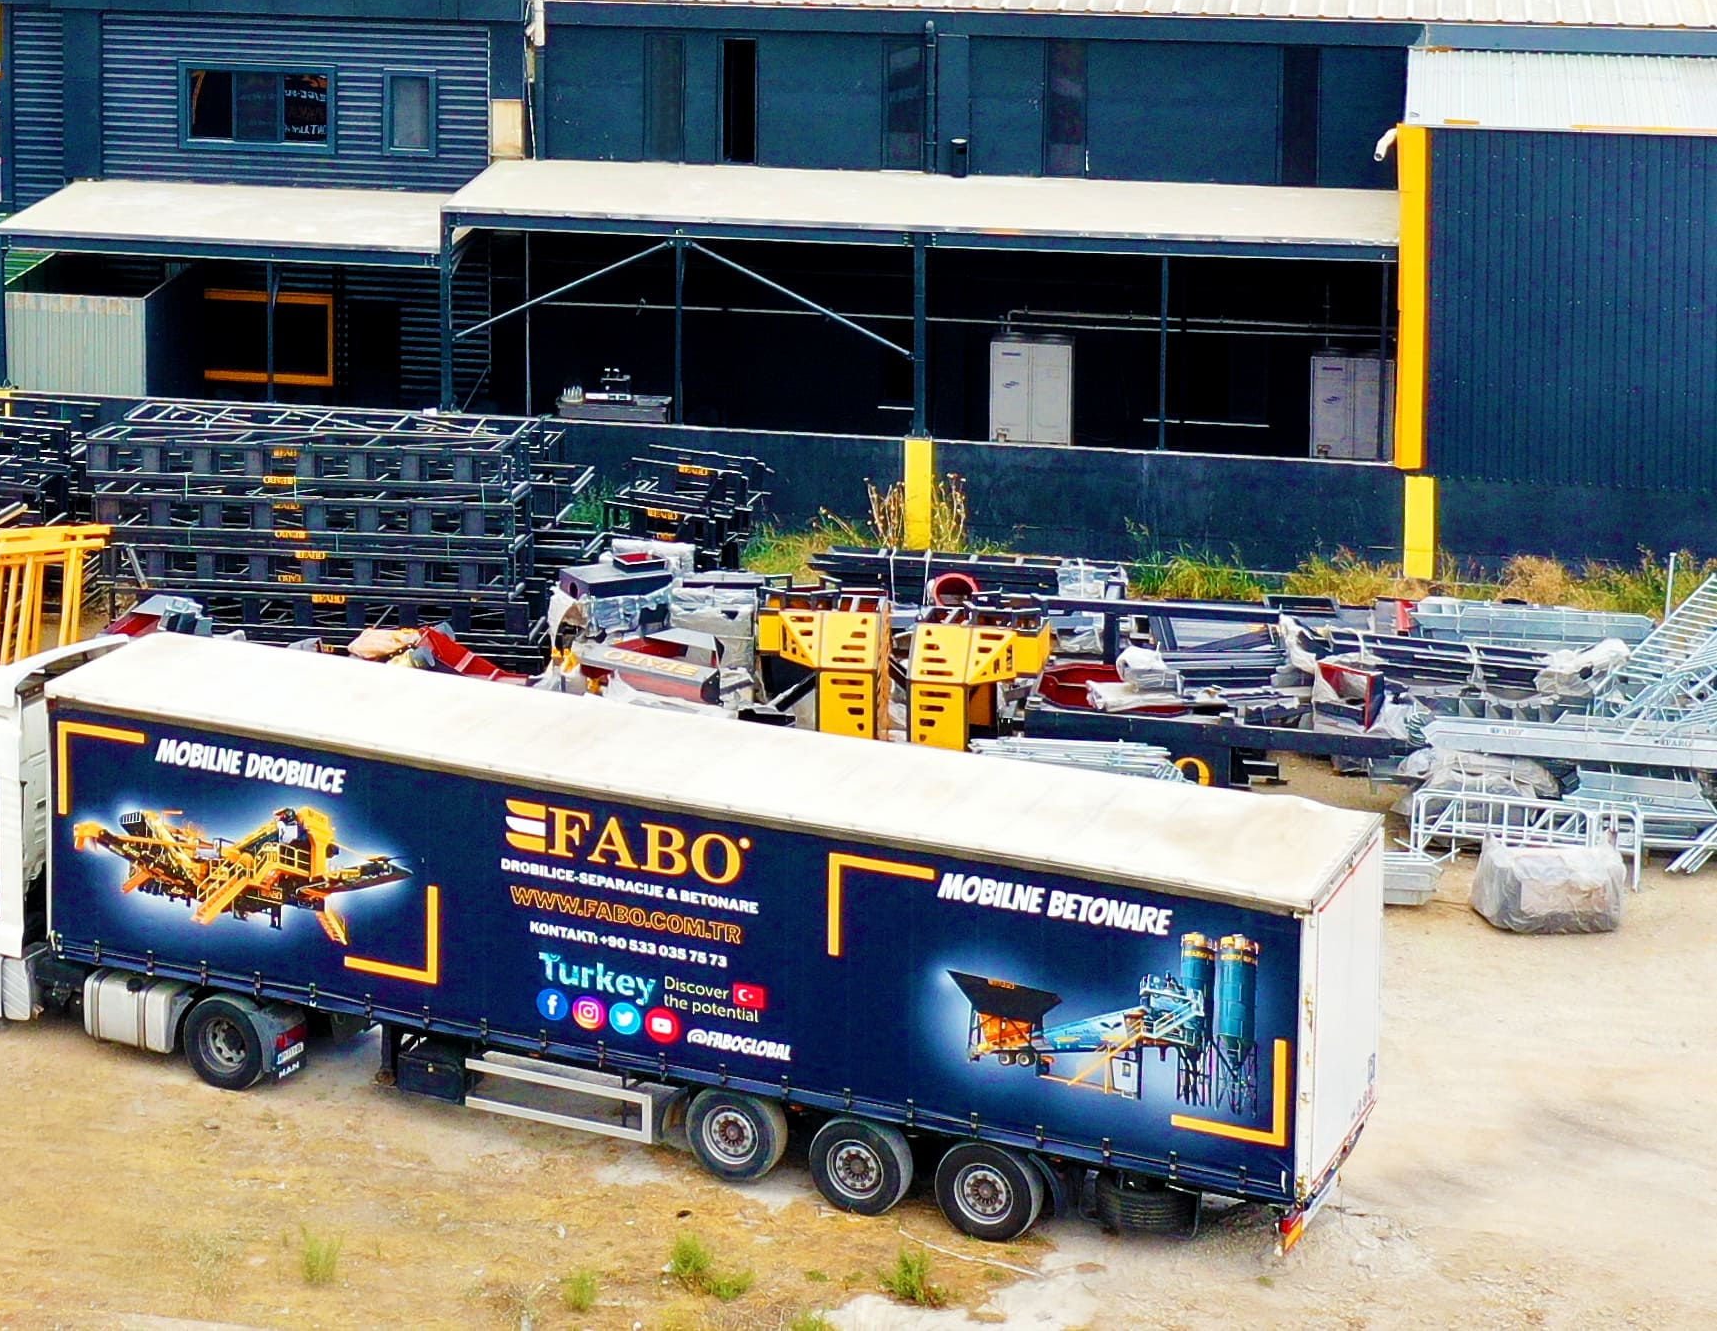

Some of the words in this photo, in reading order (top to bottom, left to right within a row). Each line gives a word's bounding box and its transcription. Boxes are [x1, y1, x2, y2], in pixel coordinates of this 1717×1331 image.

[155, 738, 243, 775] MOBILNE
[245, 753, 347, 794] DROBILICE
[548, 807, 742, 885] FABO
[500, 857, 664, 899] DROBILICE-SEPARACIJE
[665, 886, 679, 901] &
[680, 889, 760, 915] BETONARE
[937, 872, 1045, 913] MOBILNE
[1047, 890, 1173, 935] BETONARE
[510, 885, 742, 945] WWW.FABO.COM.TR
[529, 920, 598, 945] KONTAKT:
[599, 933, 628, 950] +90
[629, 939, 657, 956] 533
[658, 944, 687, 961] 035
[688, 949, 708, 965] 75
[708, 952, 728, 968] 73
[538, 951, 657, 1007] Turkey
[663, 975, 730, 1001] Discover
[663, 992, 688, 1011] the
[692, 999, 760, 1023] potential
[278, 1060, 300, 1079] MAN
[686, 1027, 792, 1061] @FABOGLOBAL
